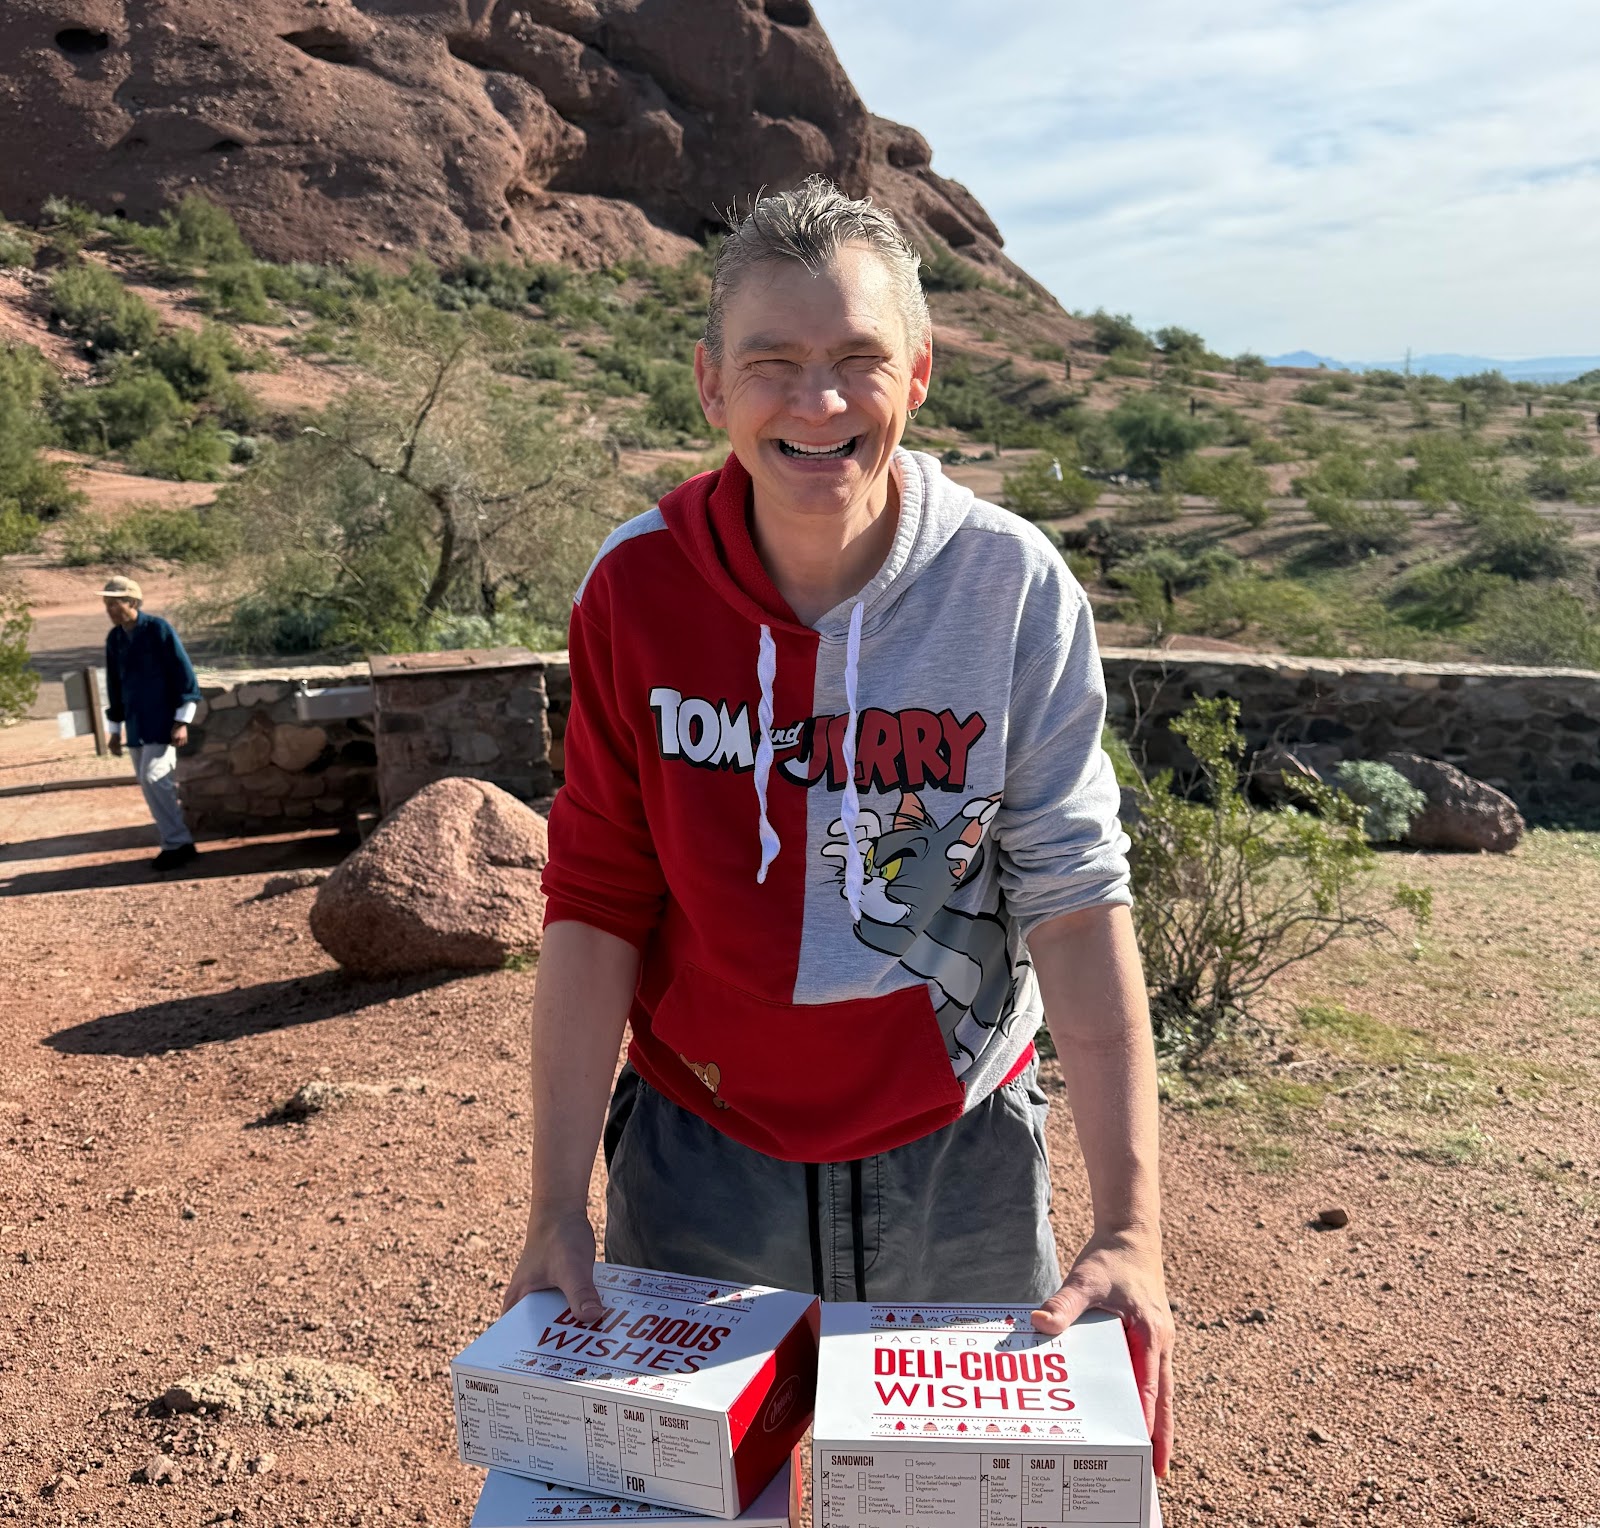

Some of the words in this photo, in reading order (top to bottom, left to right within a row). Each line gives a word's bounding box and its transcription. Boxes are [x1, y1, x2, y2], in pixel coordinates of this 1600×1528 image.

[649, 687, 755, 774] TOM
[686, 1307, 742, 1325] WITH
[874, 1335, 978, 1347] PACKED
[998, 1338, 1063, 1348] WITH
[537, 1327, 708, 1375] WISHES
[874, 1348, 1069, 1383] DELI-CIOUS
[465, 1379, 499, 1394] SANDWICH
[874, 1381, 1076, 1411] WISHES
[593, 1403, 608, 1416] SIDE
[623, 1409, 645, 1423] SALAD
[659, 1415, 689, 1430] DESSERT
[831, 1455, 874, 1466] SANDWICH
[992, 1458, 1011, 1469] SIDE
[1030, 1459, 1056, 1470] SALAD
[1073, 1459, 1108, 1470] DESSERT
[626, 1475, 646, 1494] FOR
